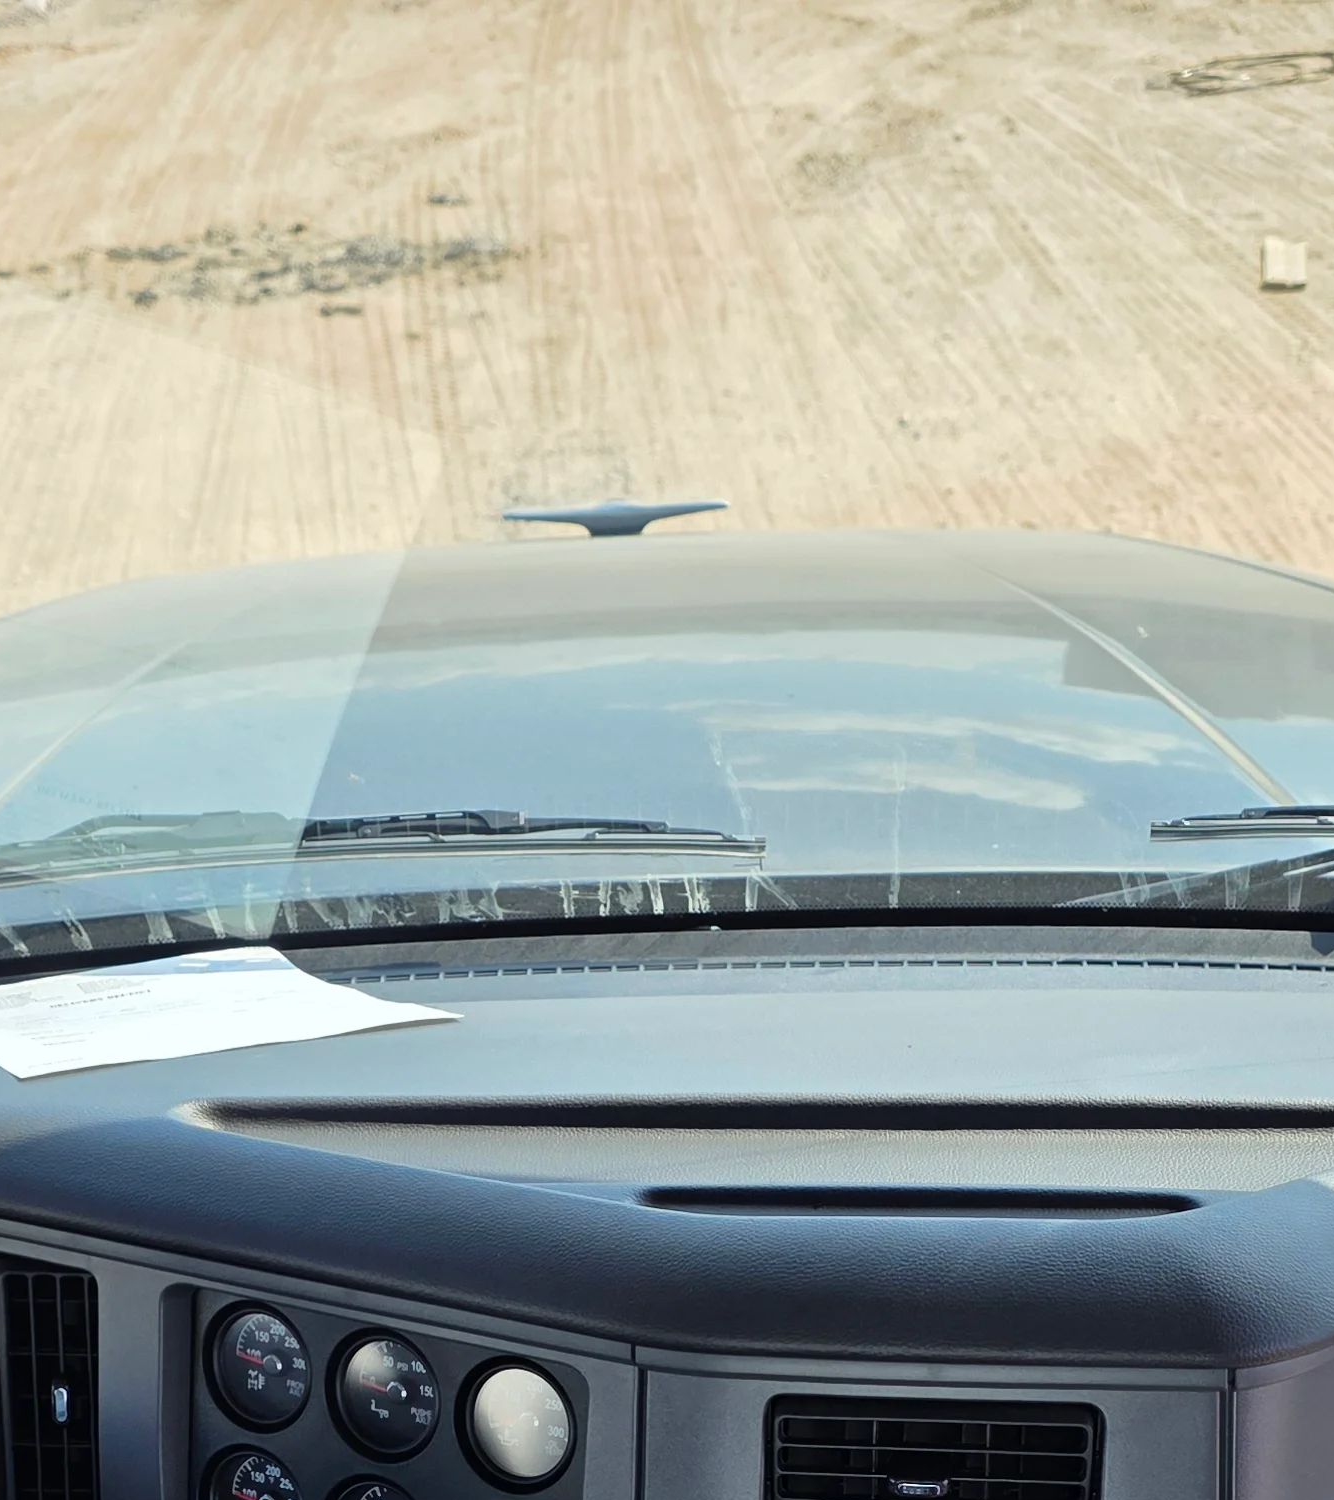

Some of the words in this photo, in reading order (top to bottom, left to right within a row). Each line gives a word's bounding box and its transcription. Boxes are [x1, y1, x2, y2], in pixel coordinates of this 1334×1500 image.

[269, 1323, 286, 1336] 200
[254, 1330, 269, 1343] 150
[383, 1355, 394, 1368] 50
[397, 1362, 409, 1372] PSI
[545, 1398, 561, 1412] 250
[547, 1425, 564, 1439] 300
[250, 1471, 265, 1484] 150
[265, 1464, 281, 1478] 200
